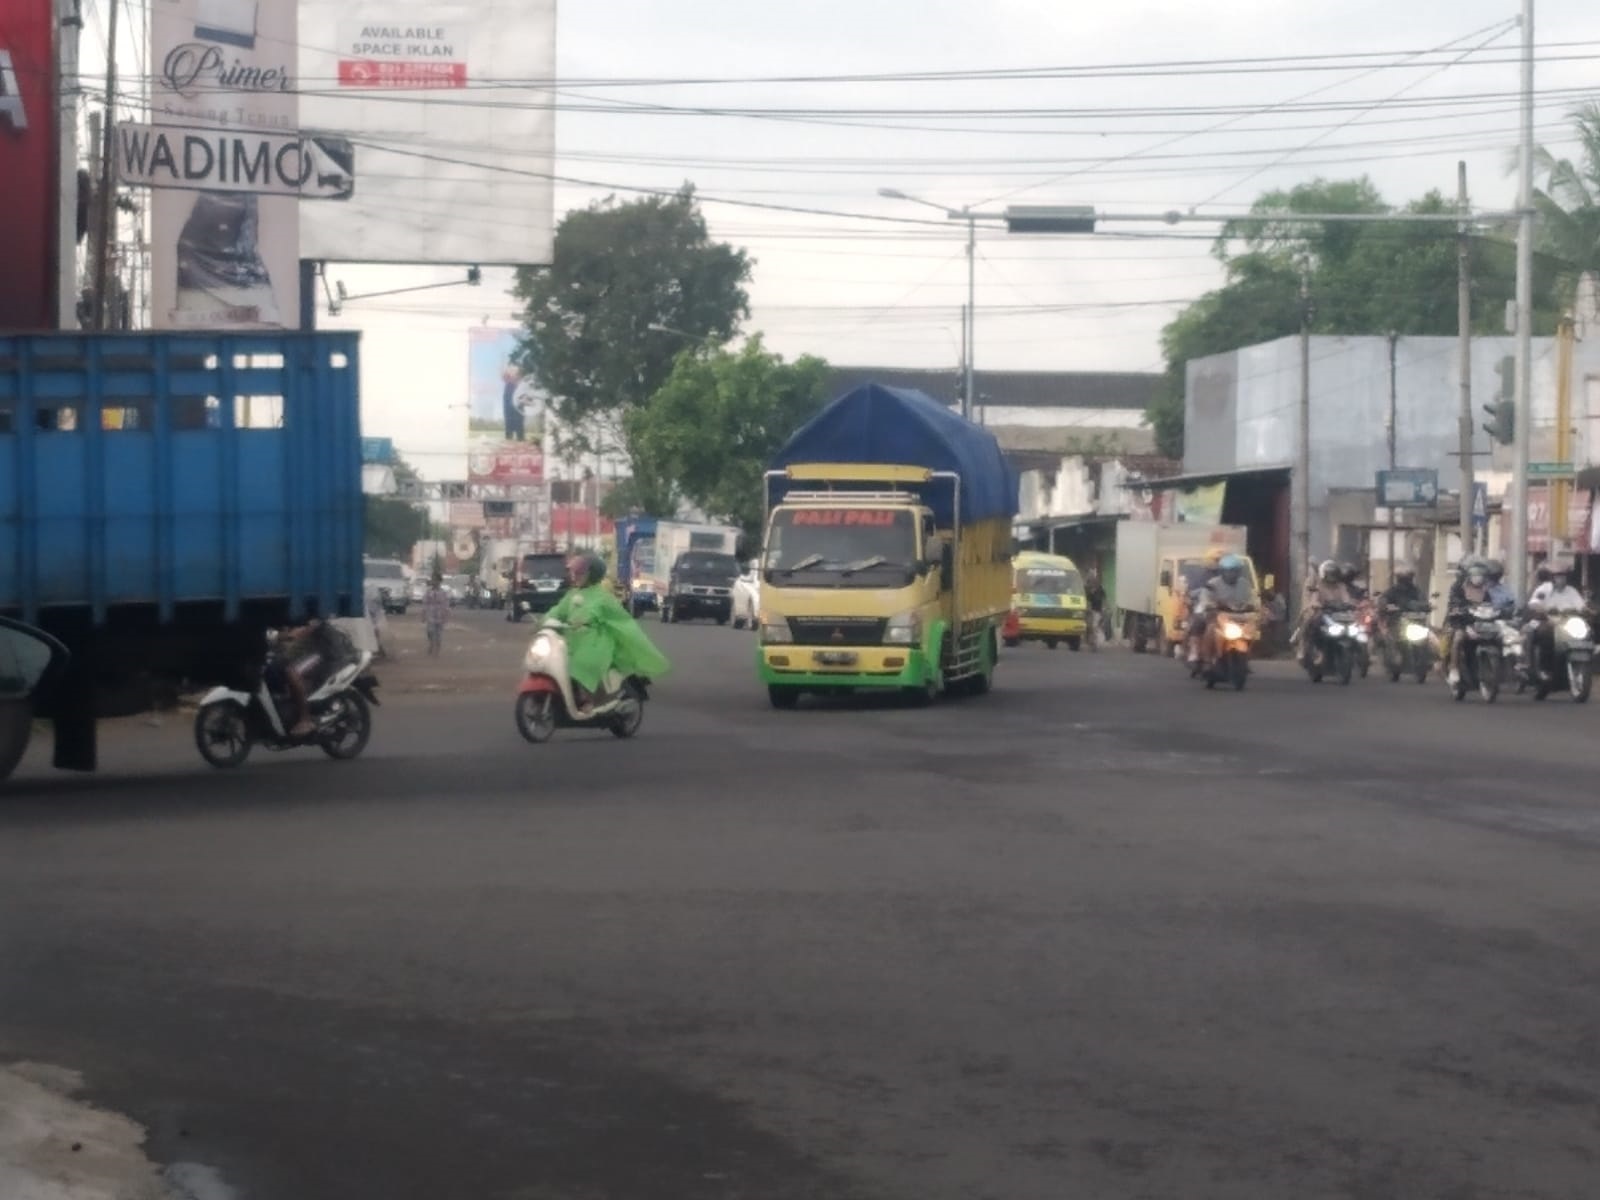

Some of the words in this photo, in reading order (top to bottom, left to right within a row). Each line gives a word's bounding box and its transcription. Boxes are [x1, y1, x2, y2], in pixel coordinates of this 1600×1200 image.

[352, 42, 401, 56] SPACE
[407, 43, 454, 57] IKLAN
[360, 26, 446, 41] AVAILABLE
[160, 42, 292, 99] Primer
[120, 126, 343, 189] WADIMO
